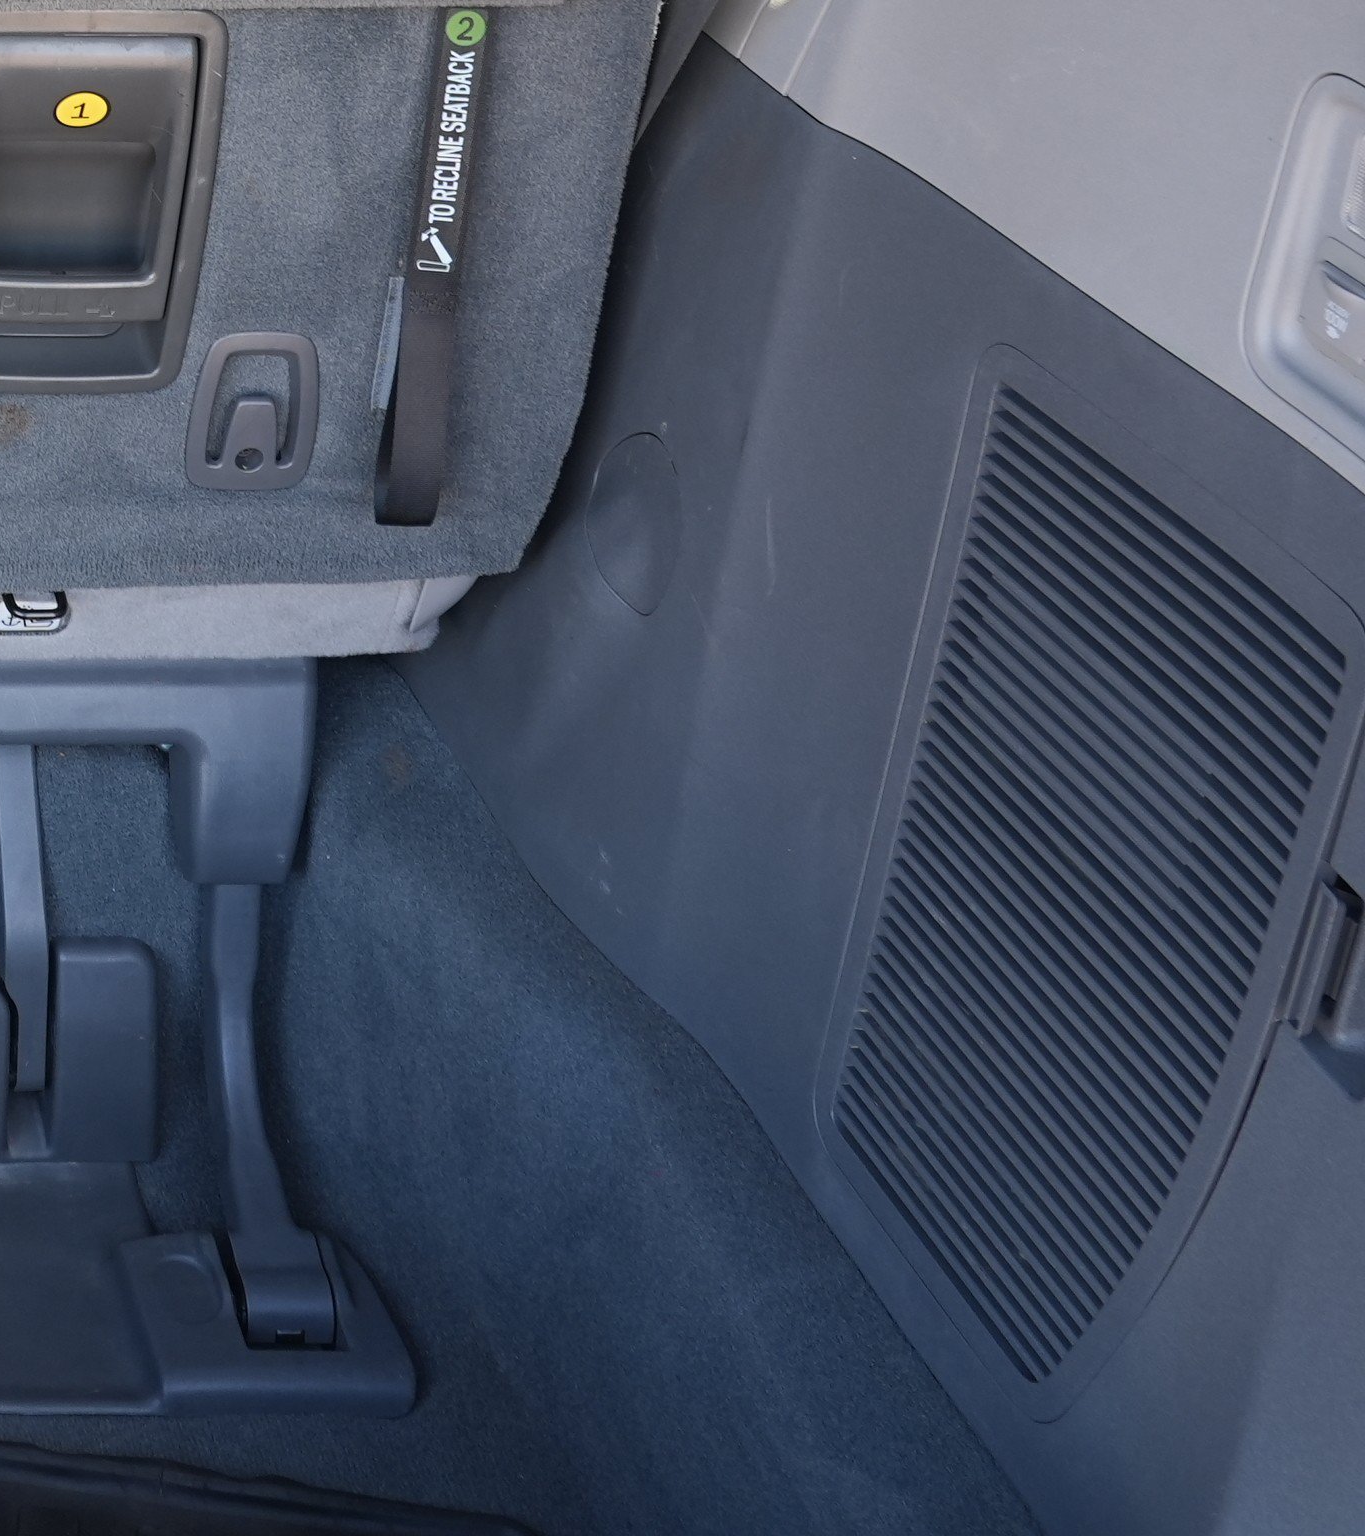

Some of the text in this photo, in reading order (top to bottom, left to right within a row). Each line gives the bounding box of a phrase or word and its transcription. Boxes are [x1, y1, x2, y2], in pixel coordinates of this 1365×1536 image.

[456, 16, 474, 41] 2
[70, 103, 90, 119] 1
[429, 50, 476, 224] TO RECLINE SEATBACK
